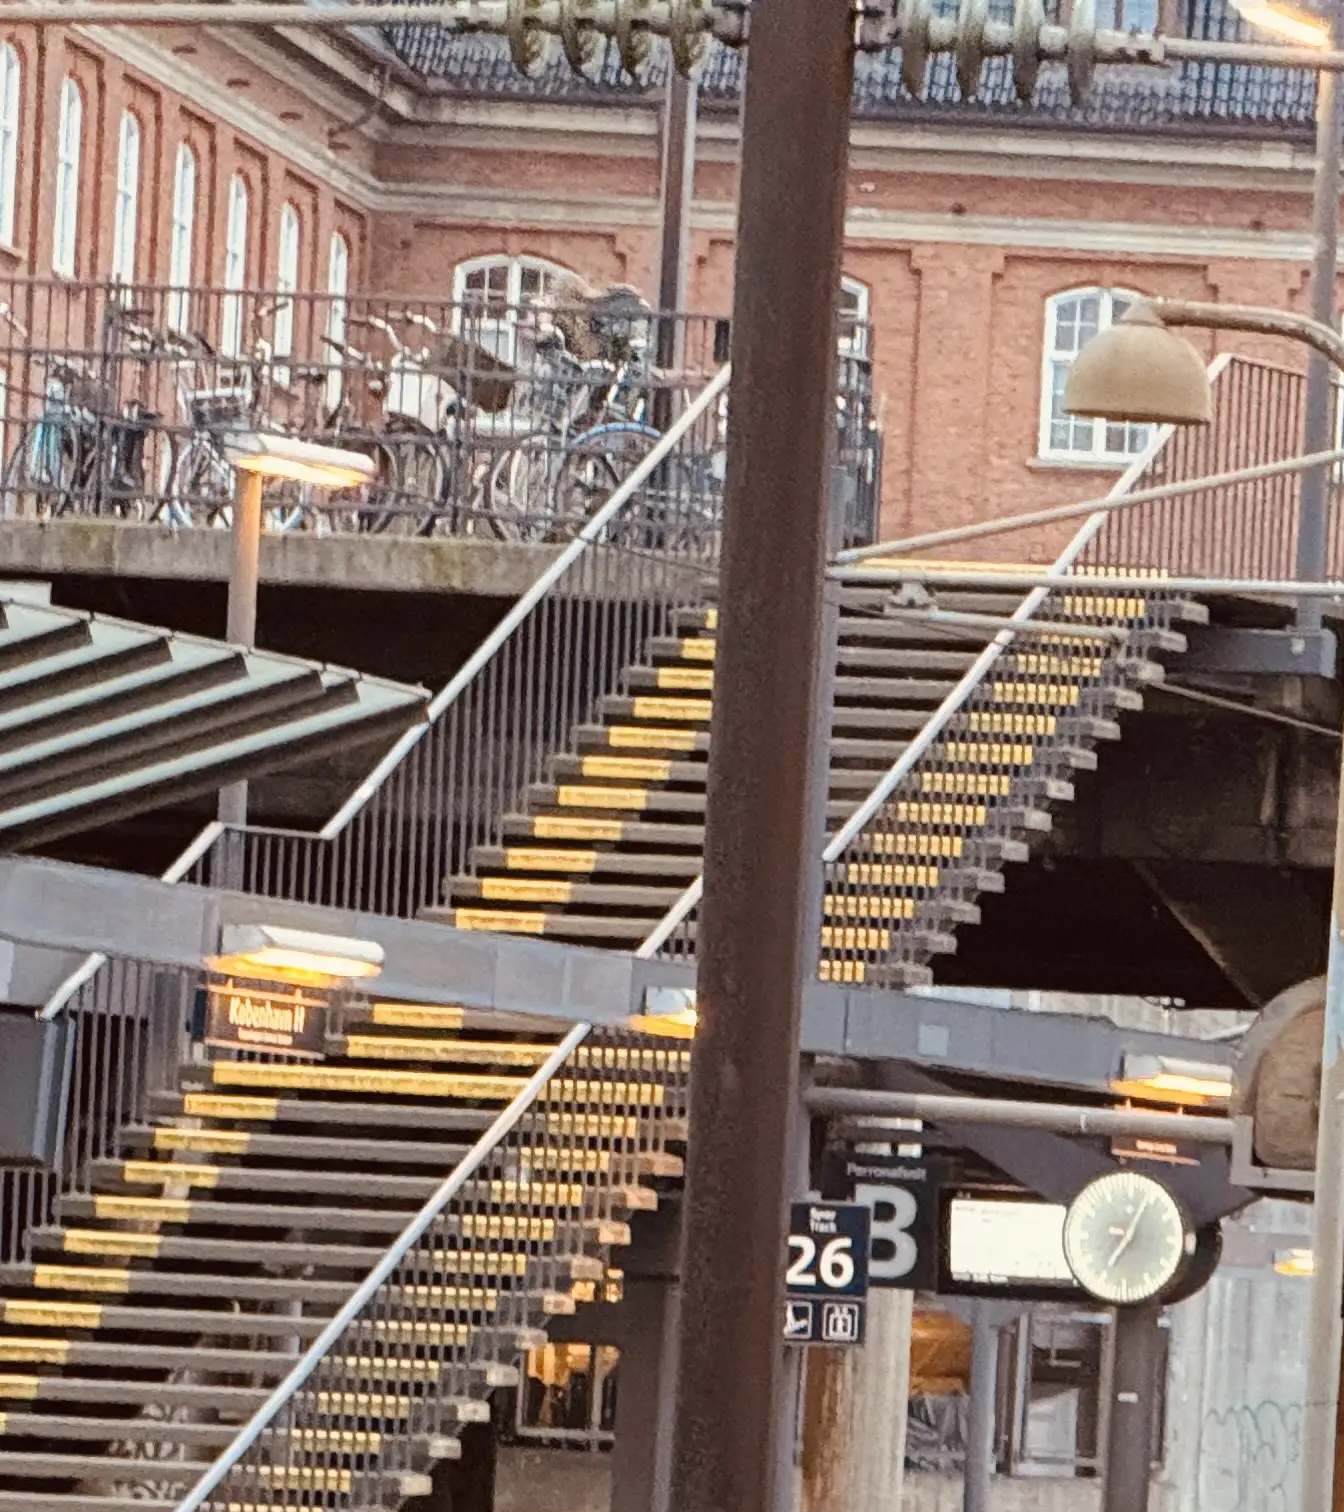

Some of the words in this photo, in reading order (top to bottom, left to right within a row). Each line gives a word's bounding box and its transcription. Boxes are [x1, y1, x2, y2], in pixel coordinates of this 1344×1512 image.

[294, 1004, 305, 1033] H
[855, 1184, 917, 1279] B
[786, 1235, 854, 1288] 26
